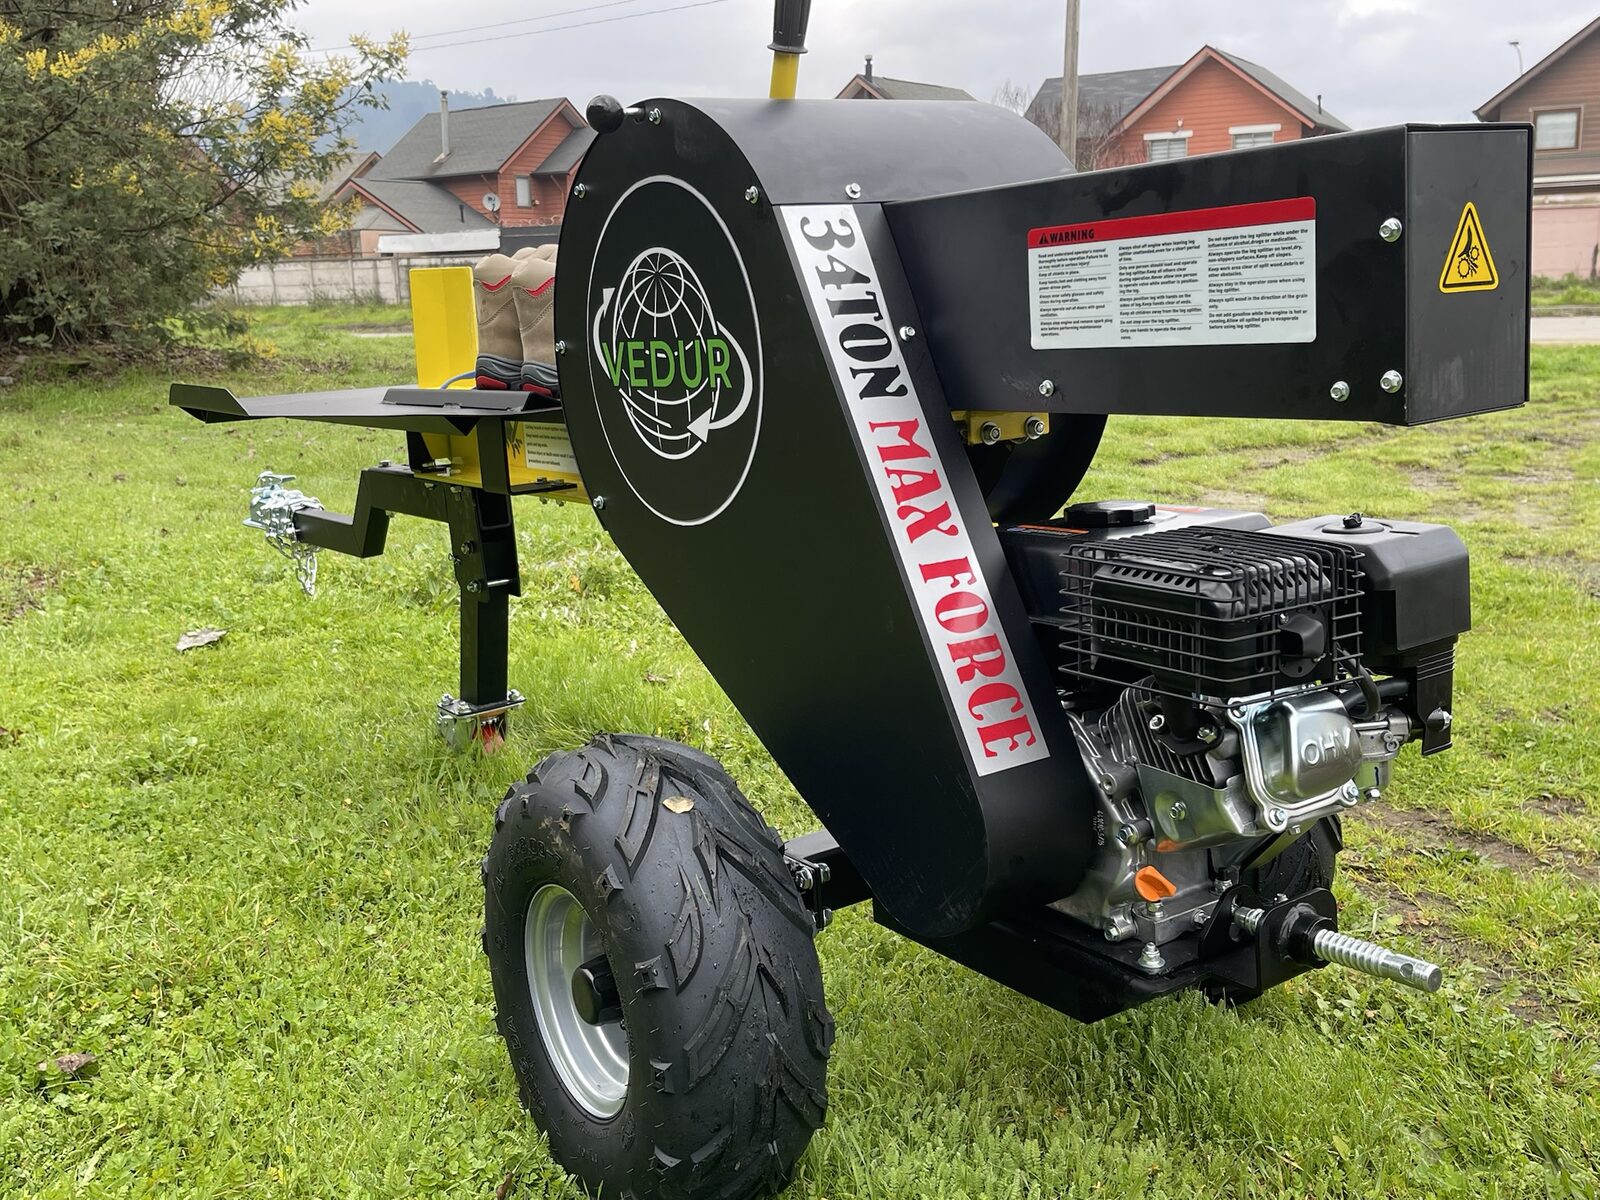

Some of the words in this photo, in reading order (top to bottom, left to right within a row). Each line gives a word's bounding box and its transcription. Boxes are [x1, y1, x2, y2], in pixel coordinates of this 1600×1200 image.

[1049, 229, 1095, 243] WARNING
[602, 338, 732, 389] VEDUR
[800, 216, 908, 400] 34TON
[868, 418, 959, 544] MAX
[918, 557, 1036, 758] FORCE
[1299, 728, 1351, 767] OHV
